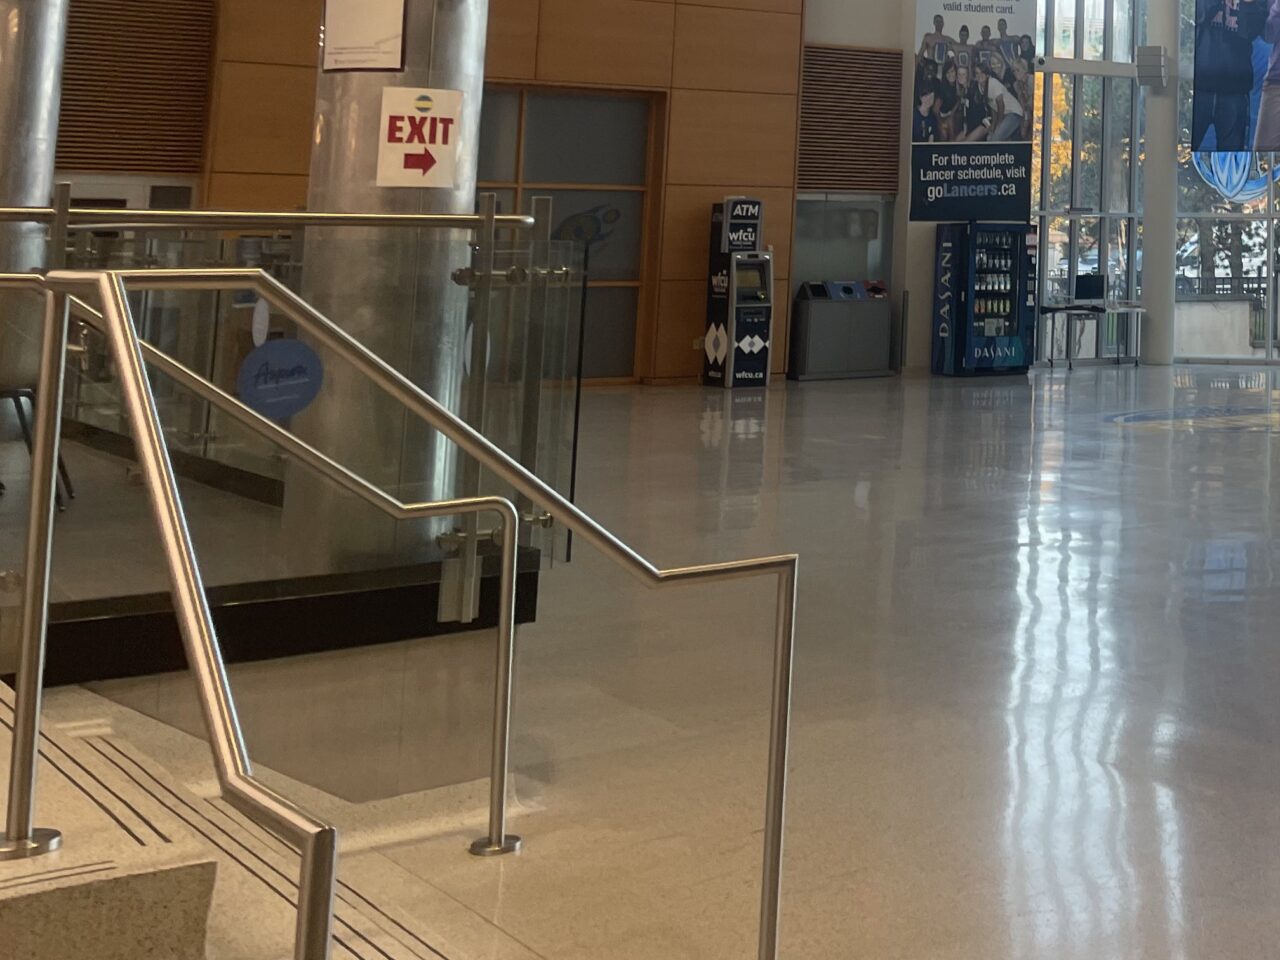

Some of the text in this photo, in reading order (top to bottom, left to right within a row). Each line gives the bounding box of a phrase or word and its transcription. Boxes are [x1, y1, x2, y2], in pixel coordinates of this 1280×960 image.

[943, 1, 1015, 15] valid student card.
[386, 114, 454, 145] EXIT
[931, 152, 1015, 168] For the complete
[920, 166, 1026, 181] Lancer schedule, visit
[927, 182, 1017, 202] goLancers.ca
[733, 204, 759, 217] ATM
[728, 228, 756, 241] wfcu
[938, 241, 953, 337] DASANI
[973, 344, 1016, 359] DASANI
[735, 370, 764, 379] wfcu.ca
